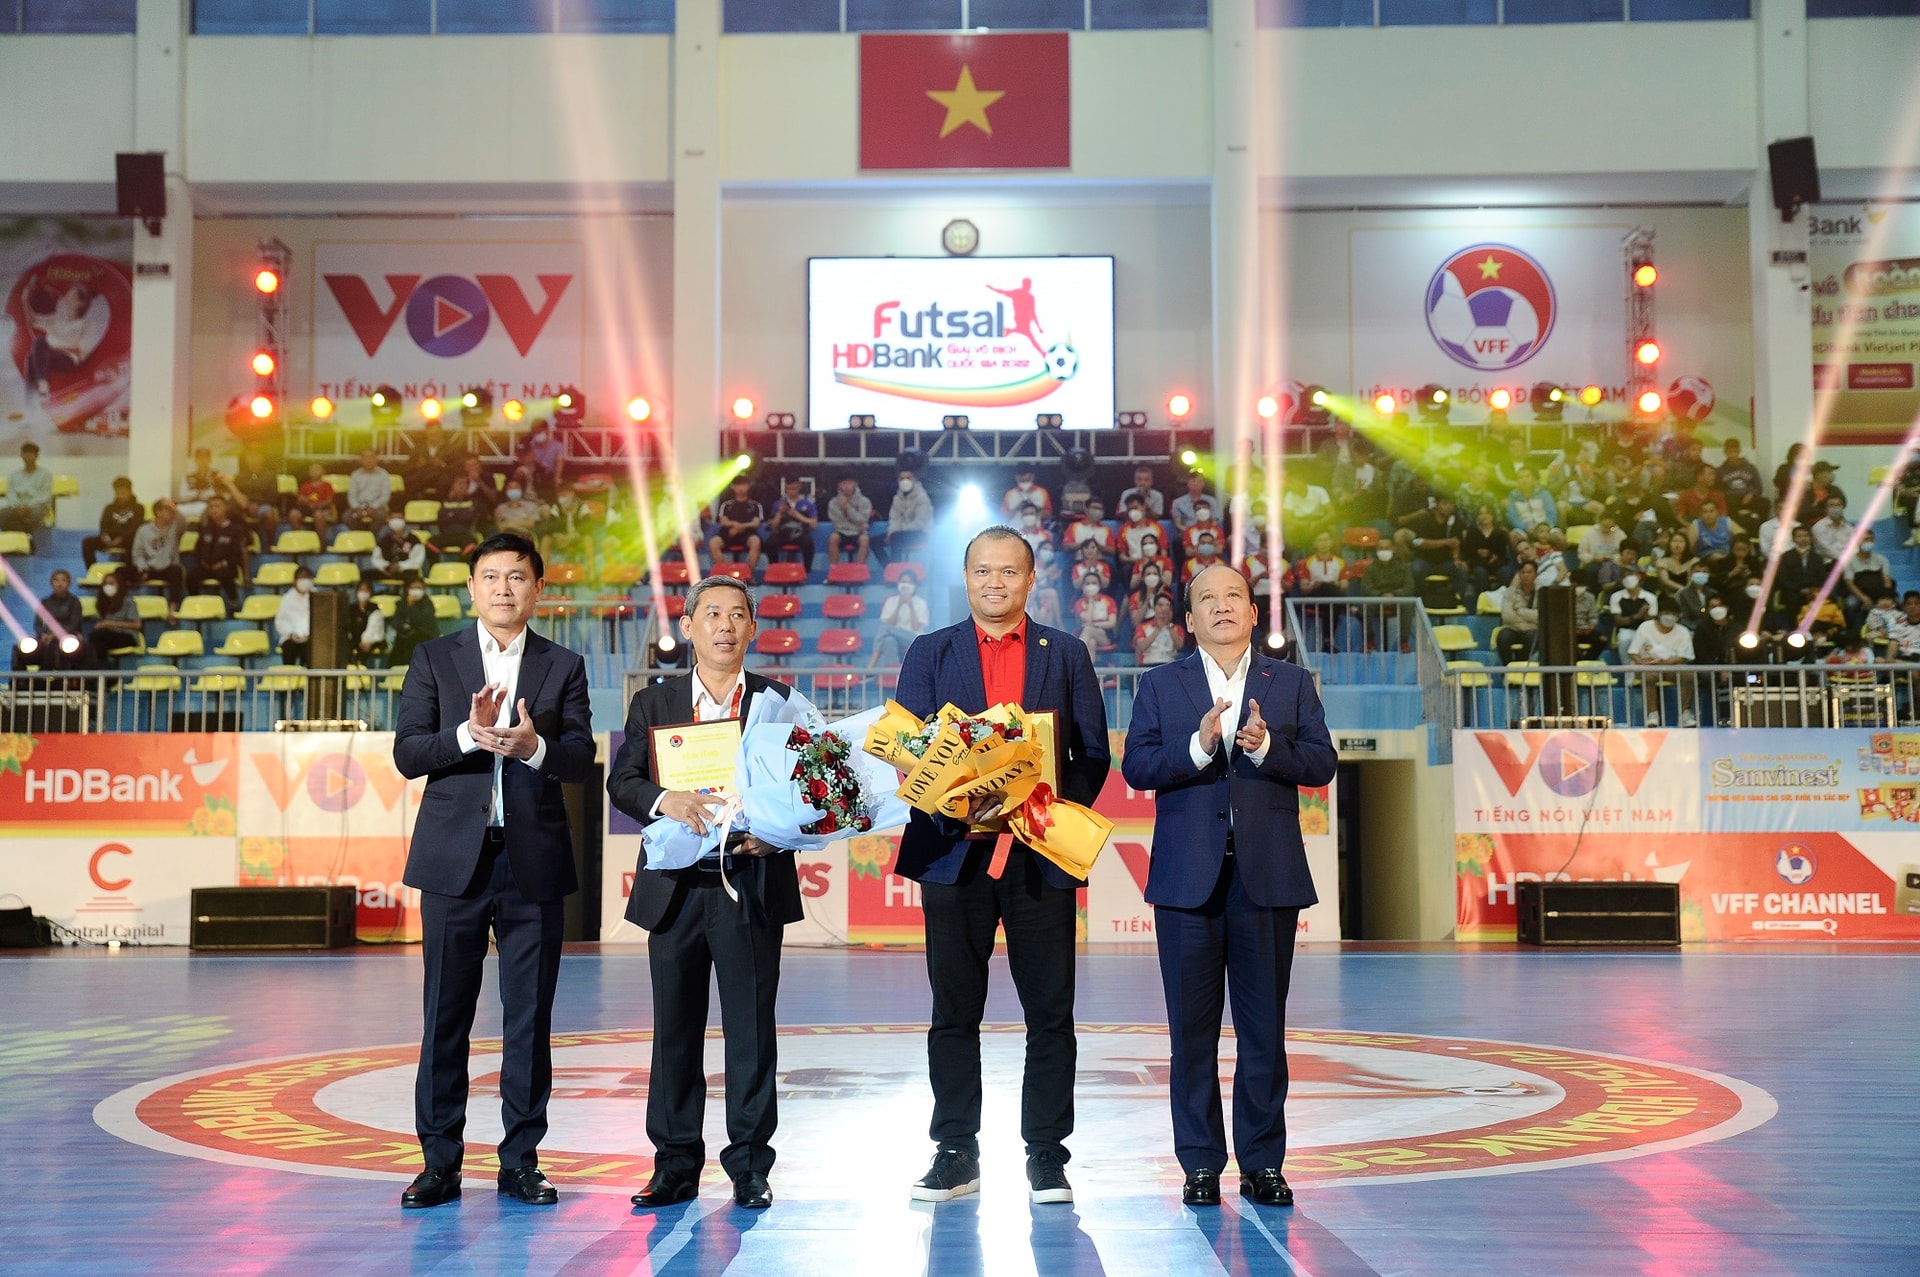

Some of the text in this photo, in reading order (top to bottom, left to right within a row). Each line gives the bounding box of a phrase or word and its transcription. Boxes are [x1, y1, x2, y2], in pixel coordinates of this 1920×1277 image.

[873, 300, 1005, 338] Futsal
[833, 343, 943, 368] HDBank
[1473, 339, 1511, 354] VFF
[320, 377, 384, 398] TIẾN
[929, 731, 961, 767] YOU
[25, 768, 184, 803] HDBank
[904, 767, 938, 803] LOVE
[1712, 756, 1839, 787] Sanvinest
[1474, 805, 1673, 826] TIẾNG NÓI VIỆT NAM
[1711, 893, 1759, 914] VFF
[1763, 893, 1887, 914] CHANNEL
[54, 924, 164, 939] Central Capital
[1112, 916, 1154, 932] TIẾN
[1470, 1050, 1689, 1093] FUTSAL
[180, 1087, 374, 1150] HDBANK
[1417, 1095, 1698, 1157] HDBANK
